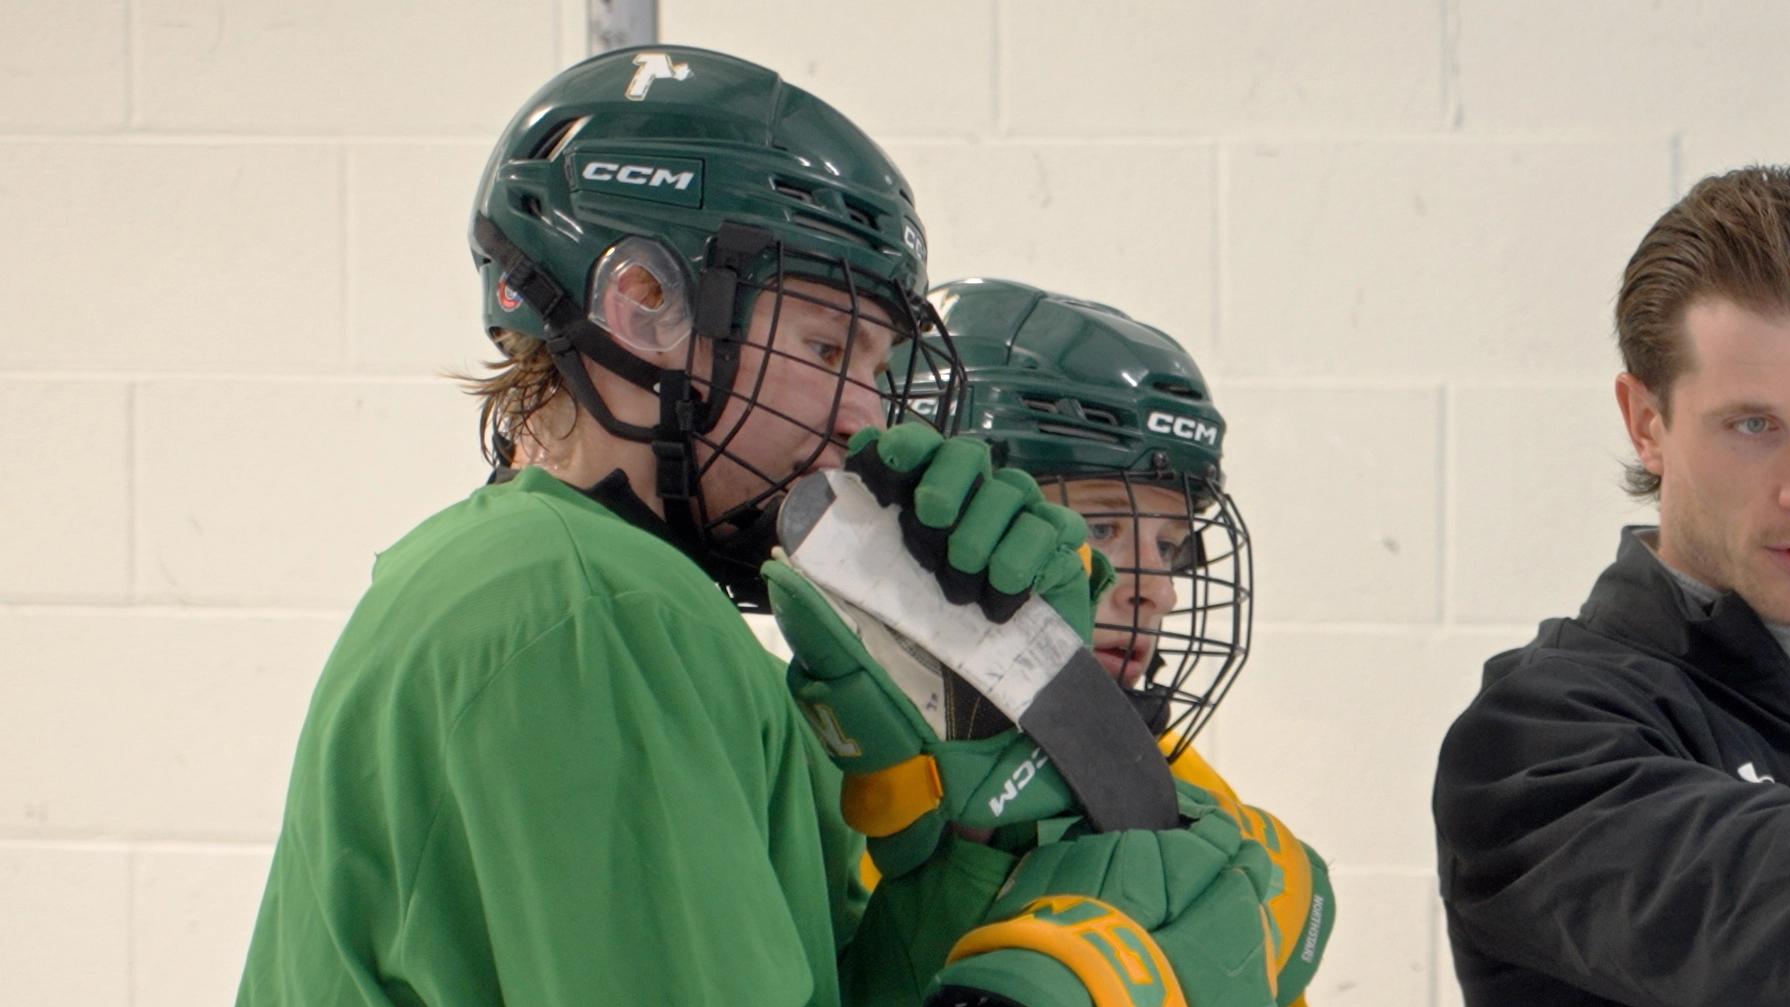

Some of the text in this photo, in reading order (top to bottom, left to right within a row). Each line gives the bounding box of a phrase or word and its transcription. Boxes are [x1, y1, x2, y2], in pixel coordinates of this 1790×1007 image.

[582, 161, 695, 191] CCM
[1146, 411, 1218, 446] CCM
[1301, 893, 1325, 963] NORTHSTARS
